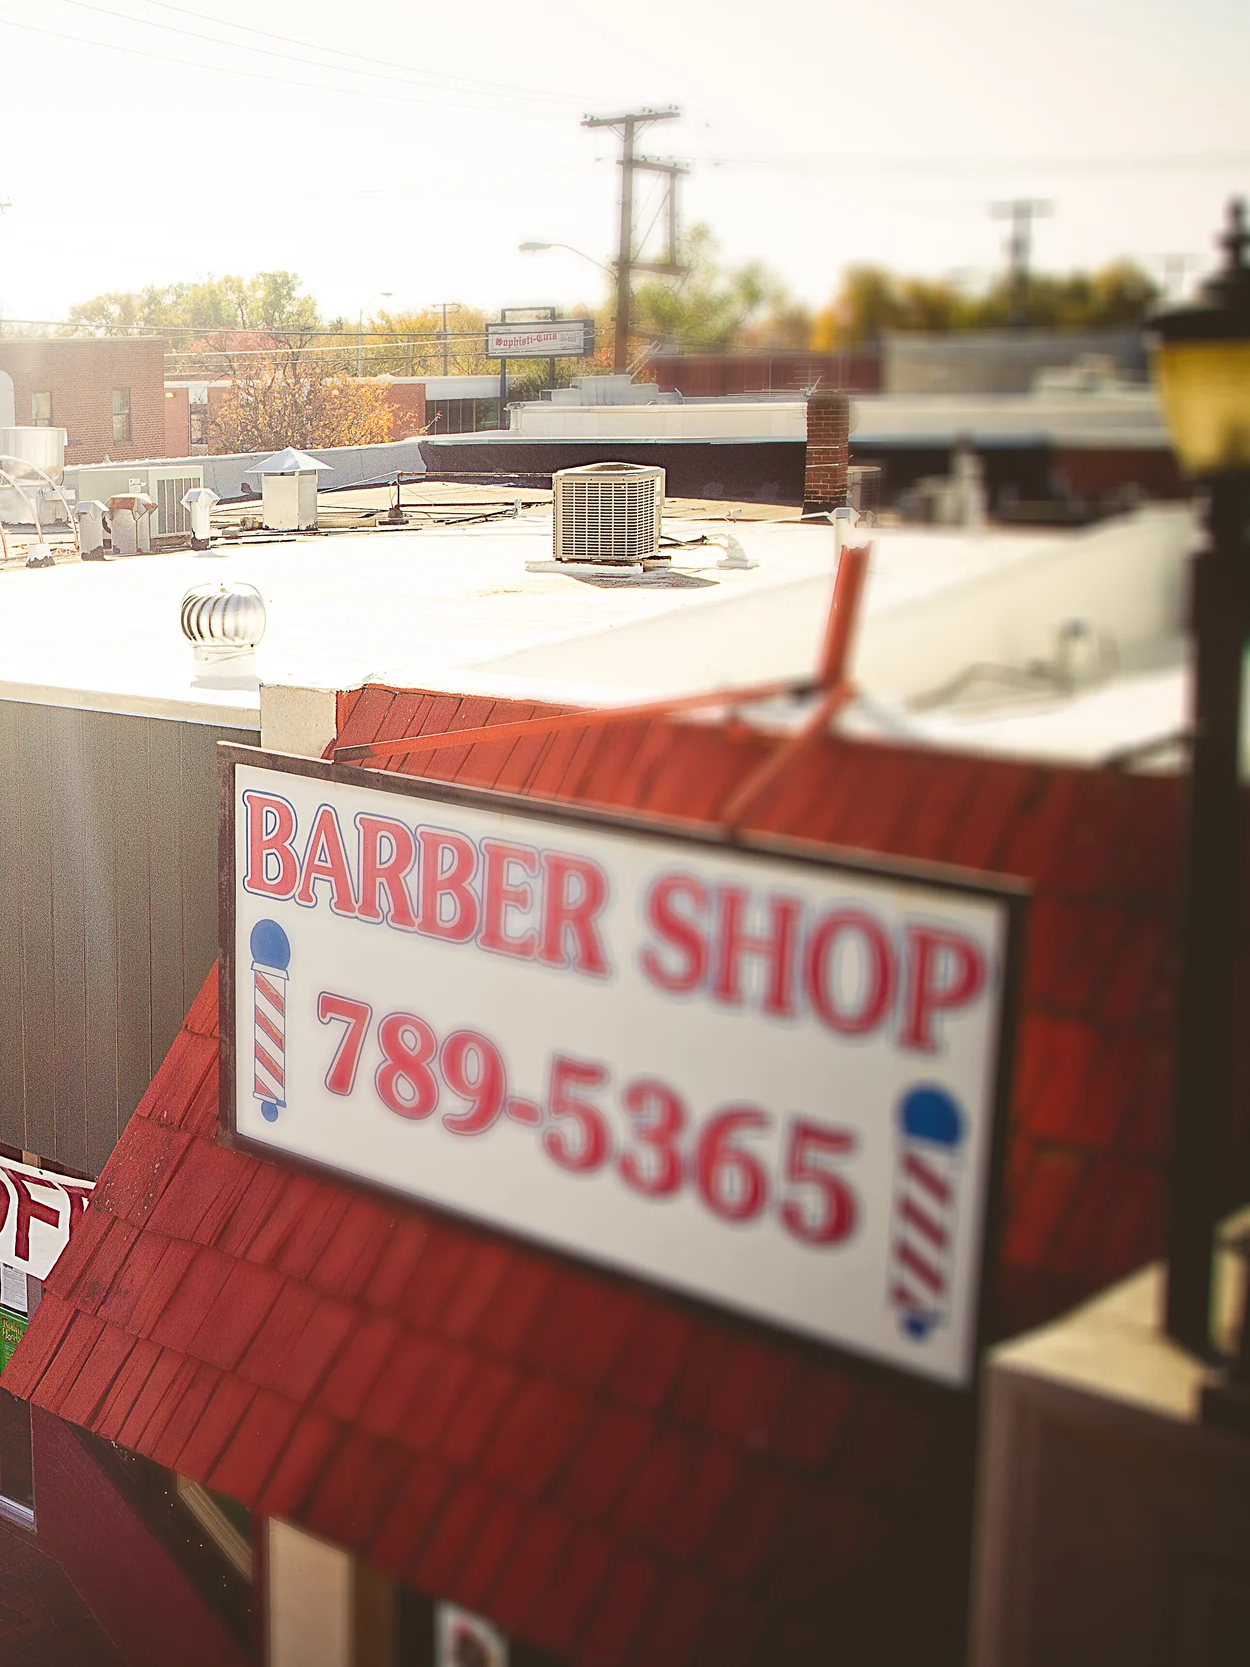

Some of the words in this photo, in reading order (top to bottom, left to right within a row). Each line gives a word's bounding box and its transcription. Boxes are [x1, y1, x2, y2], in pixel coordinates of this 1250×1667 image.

[242, 789, 610, 978] BARBER
[640, 870, 988, 1056] SHOP
[317, 991, 859, 1249] 789-5365
